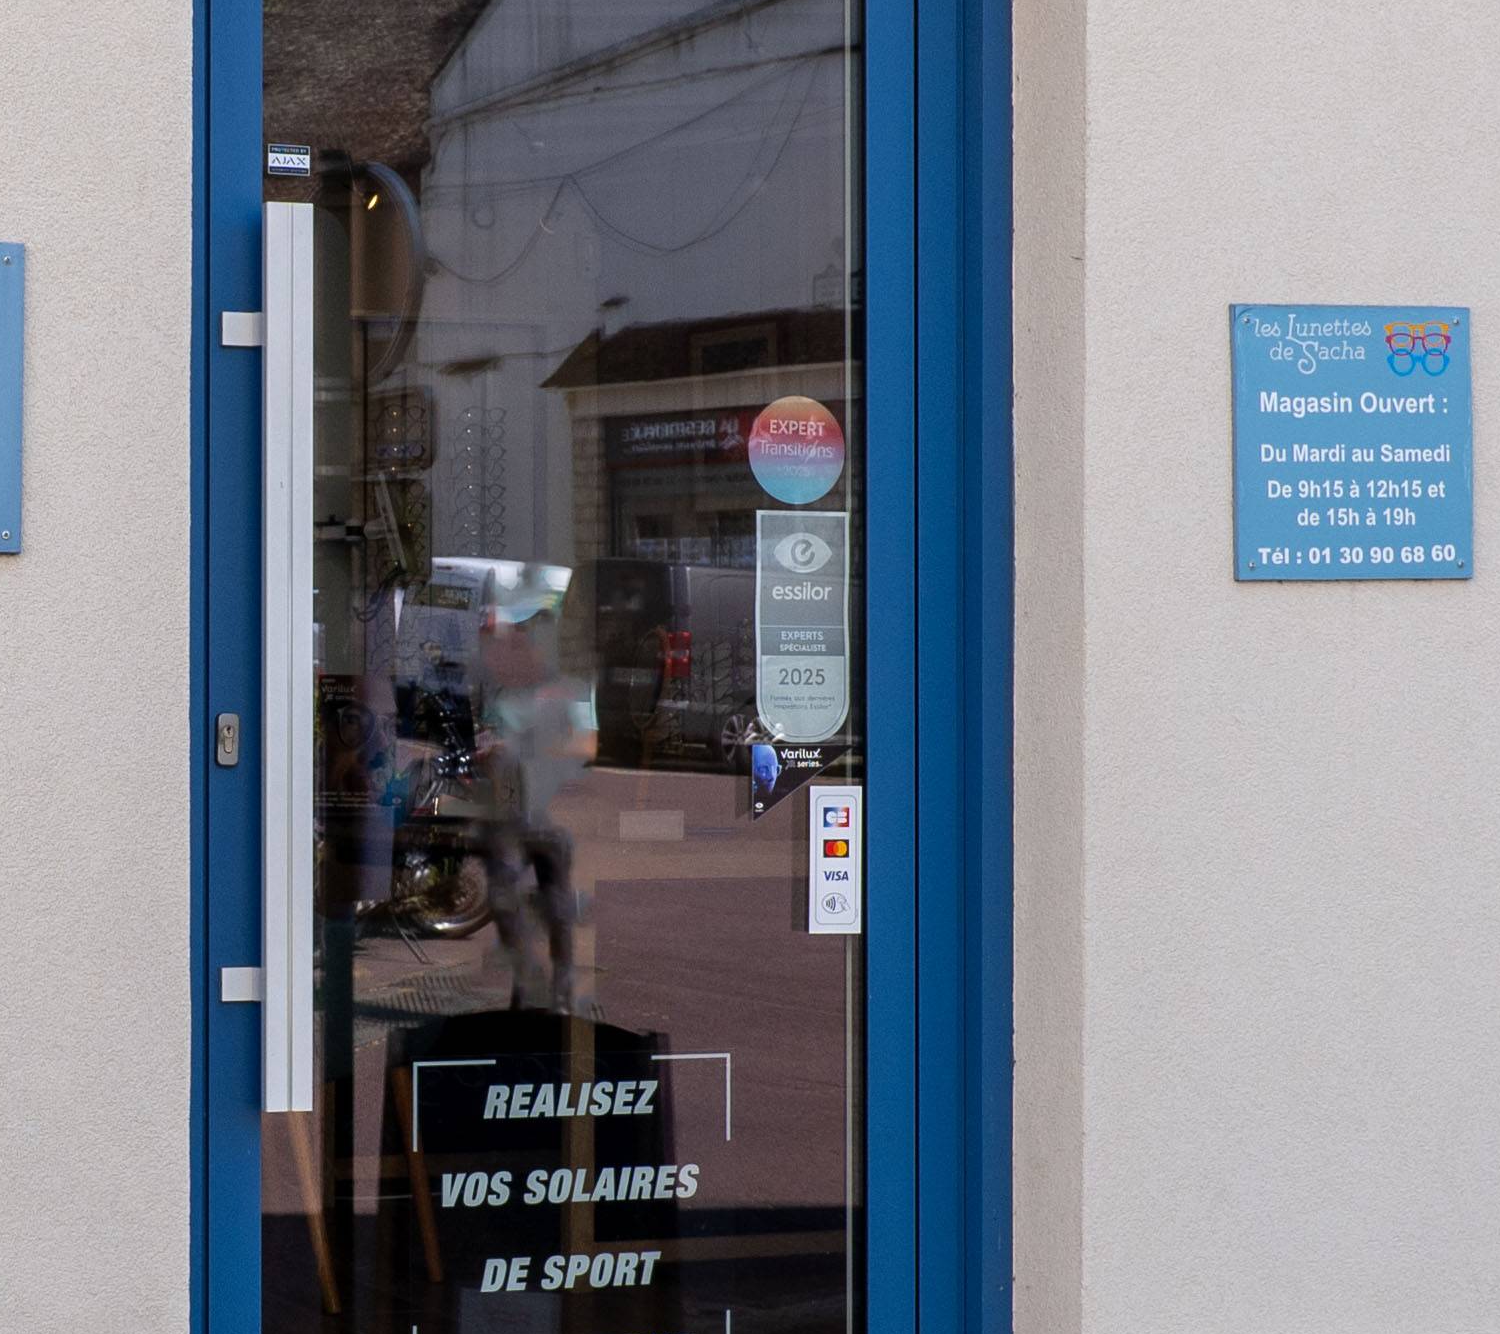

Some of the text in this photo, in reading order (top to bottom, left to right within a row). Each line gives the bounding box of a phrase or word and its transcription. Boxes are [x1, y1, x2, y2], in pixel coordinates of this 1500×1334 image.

[271, 156, 306, 165] AJAX
[1254, 314, 1371, 344] les Lunettes
[1269, 341, 1365, 375] de Sacha
[1260, 392, 1352, 418] Magasin
[1360, 392, 1435, 414] Ouvert
[769, 419, 825, 436] EXPERT
[759, 440, 833, 460] Transitions
[1260, 443, 1450, 462] Du Mardi au Samedi
[1268, 480, 1445, 498] De 9h15 à 12h15 et
[1297, 507, 1415, 525] de 15h à 19h
[1258, 546, 1290, 565] Tél
[1309, 548, 1331, 564] 01
[1340, 547, 1363, 564] 30
[1370, 547, 1393, 563] 90
[1400, 546, 1424, 563] 68
[1431, 545, 1455, 561] 60
[772, 582, 832, 601] essilor
[780, 631, 824, 641] EXPERTS
[779, 668, 825, 685] 2025
[781, 748, 821, 759] Varilux
[824, 871, 849, 881] VISA
[483, 1080, 658, 1120] REALISEZ
[441, 1164, 700, 1208] VOS SOLAIRES
[480, 1251, 661, 1293] DE SPORT
